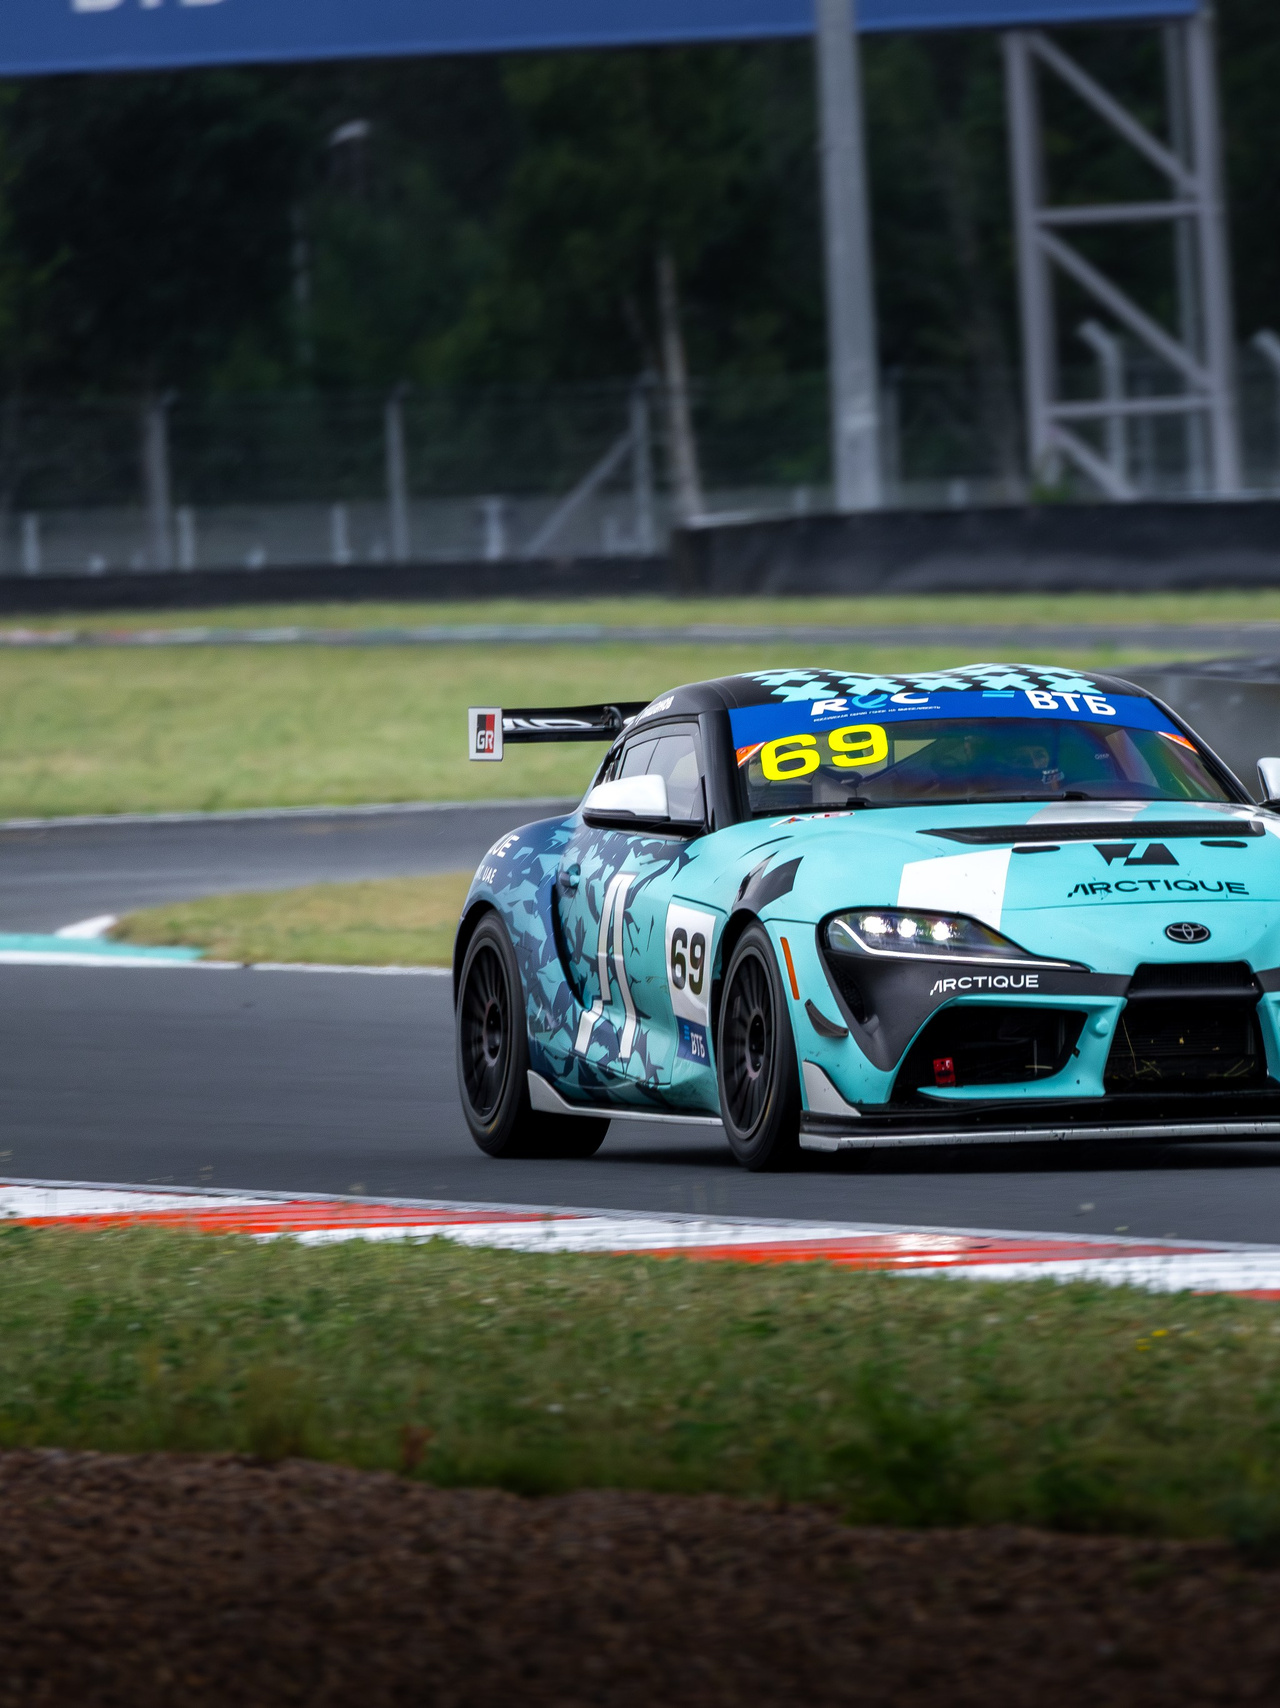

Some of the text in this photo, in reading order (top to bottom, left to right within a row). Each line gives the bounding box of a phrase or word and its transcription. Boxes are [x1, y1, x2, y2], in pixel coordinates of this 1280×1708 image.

[1025, 690, 1116, 716] ВТБ
[477, 730, 494, 748] GR
[760, 723, 889, 781] 69
[1067, 879, 1250, 898] ARCTIQUE
[670, 927, 706, 996] 69
[929, 974, 1039, 996] ARCTIQUE
[690, 1031, 706, 1059] ВТБ
